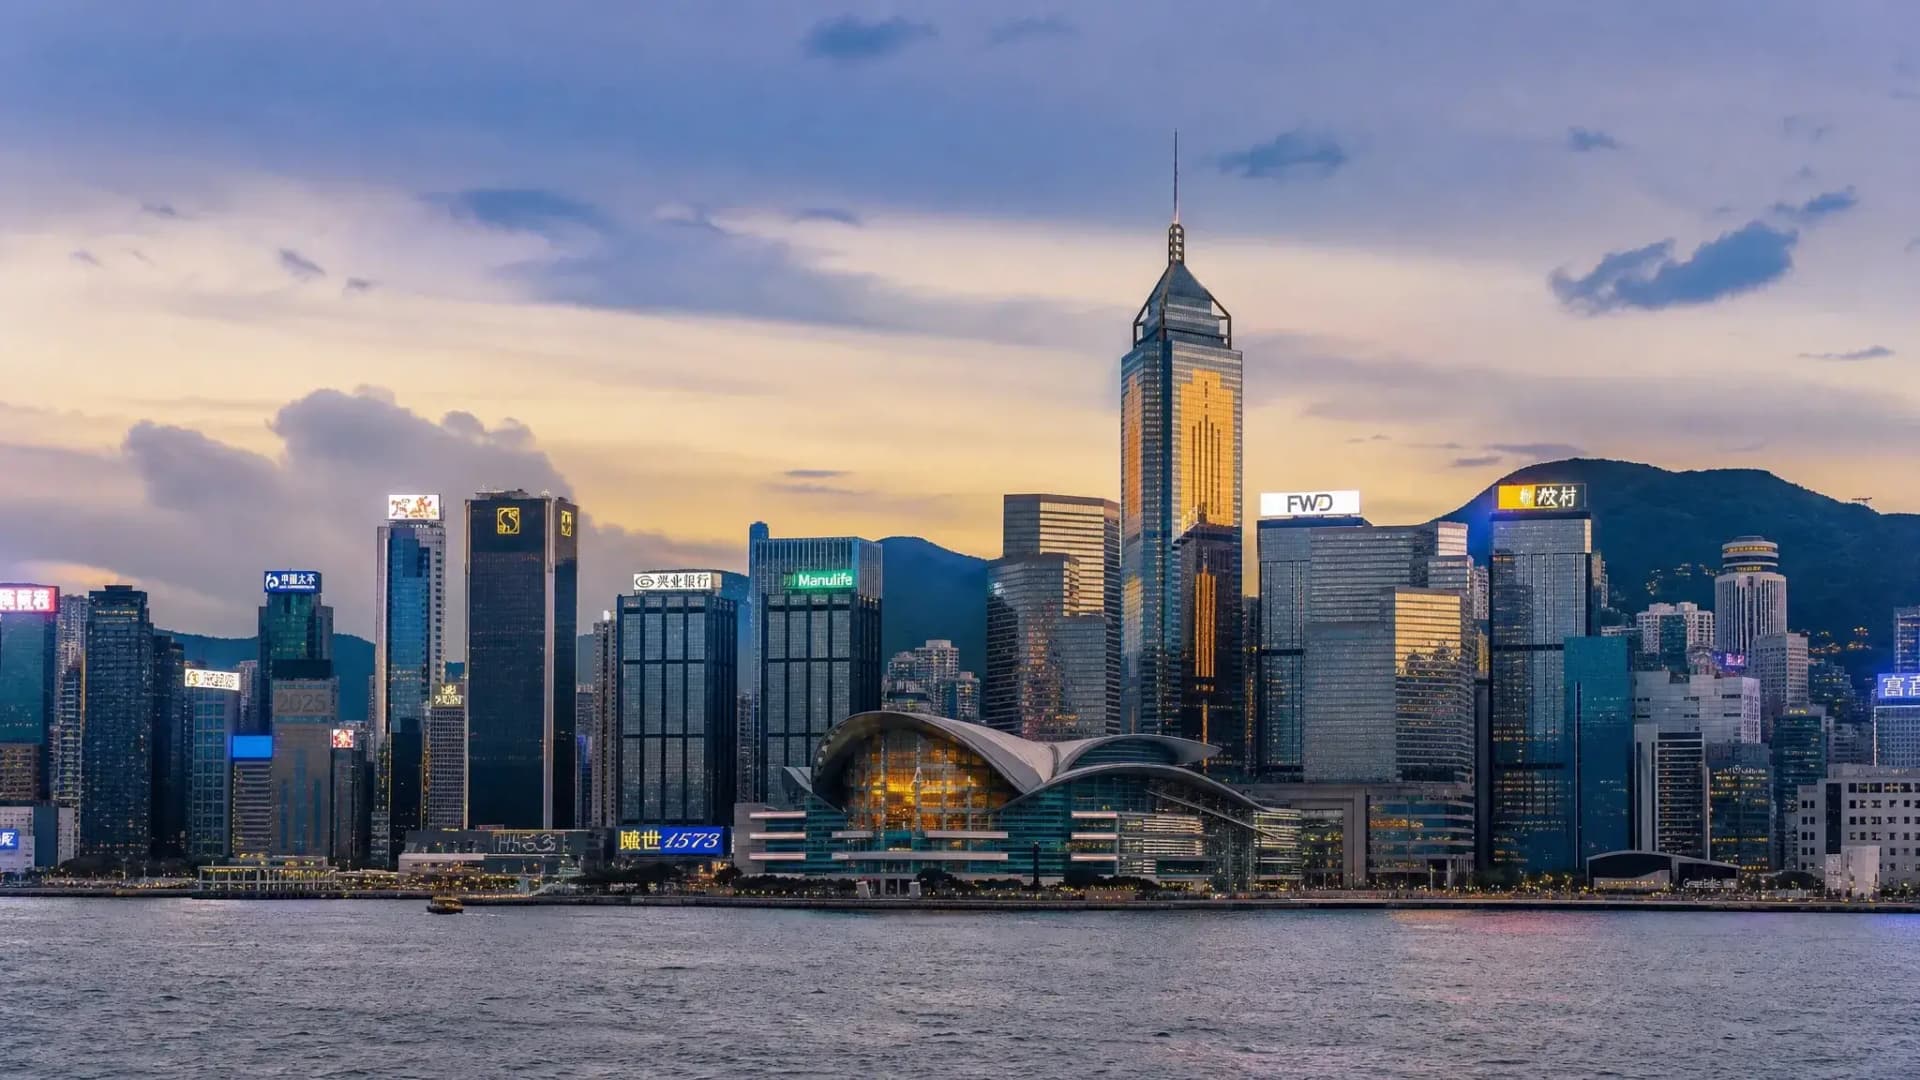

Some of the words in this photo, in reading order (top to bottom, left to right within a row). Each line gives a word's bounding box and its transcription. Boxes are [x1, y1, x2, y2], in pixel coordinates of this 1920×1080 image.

[1287, 494, 1333, 512] FWD
[798, 572, 852, 588] Manulife
[277, 694, 326, 713] 2025
[664, 832, 720, 849] 1573
